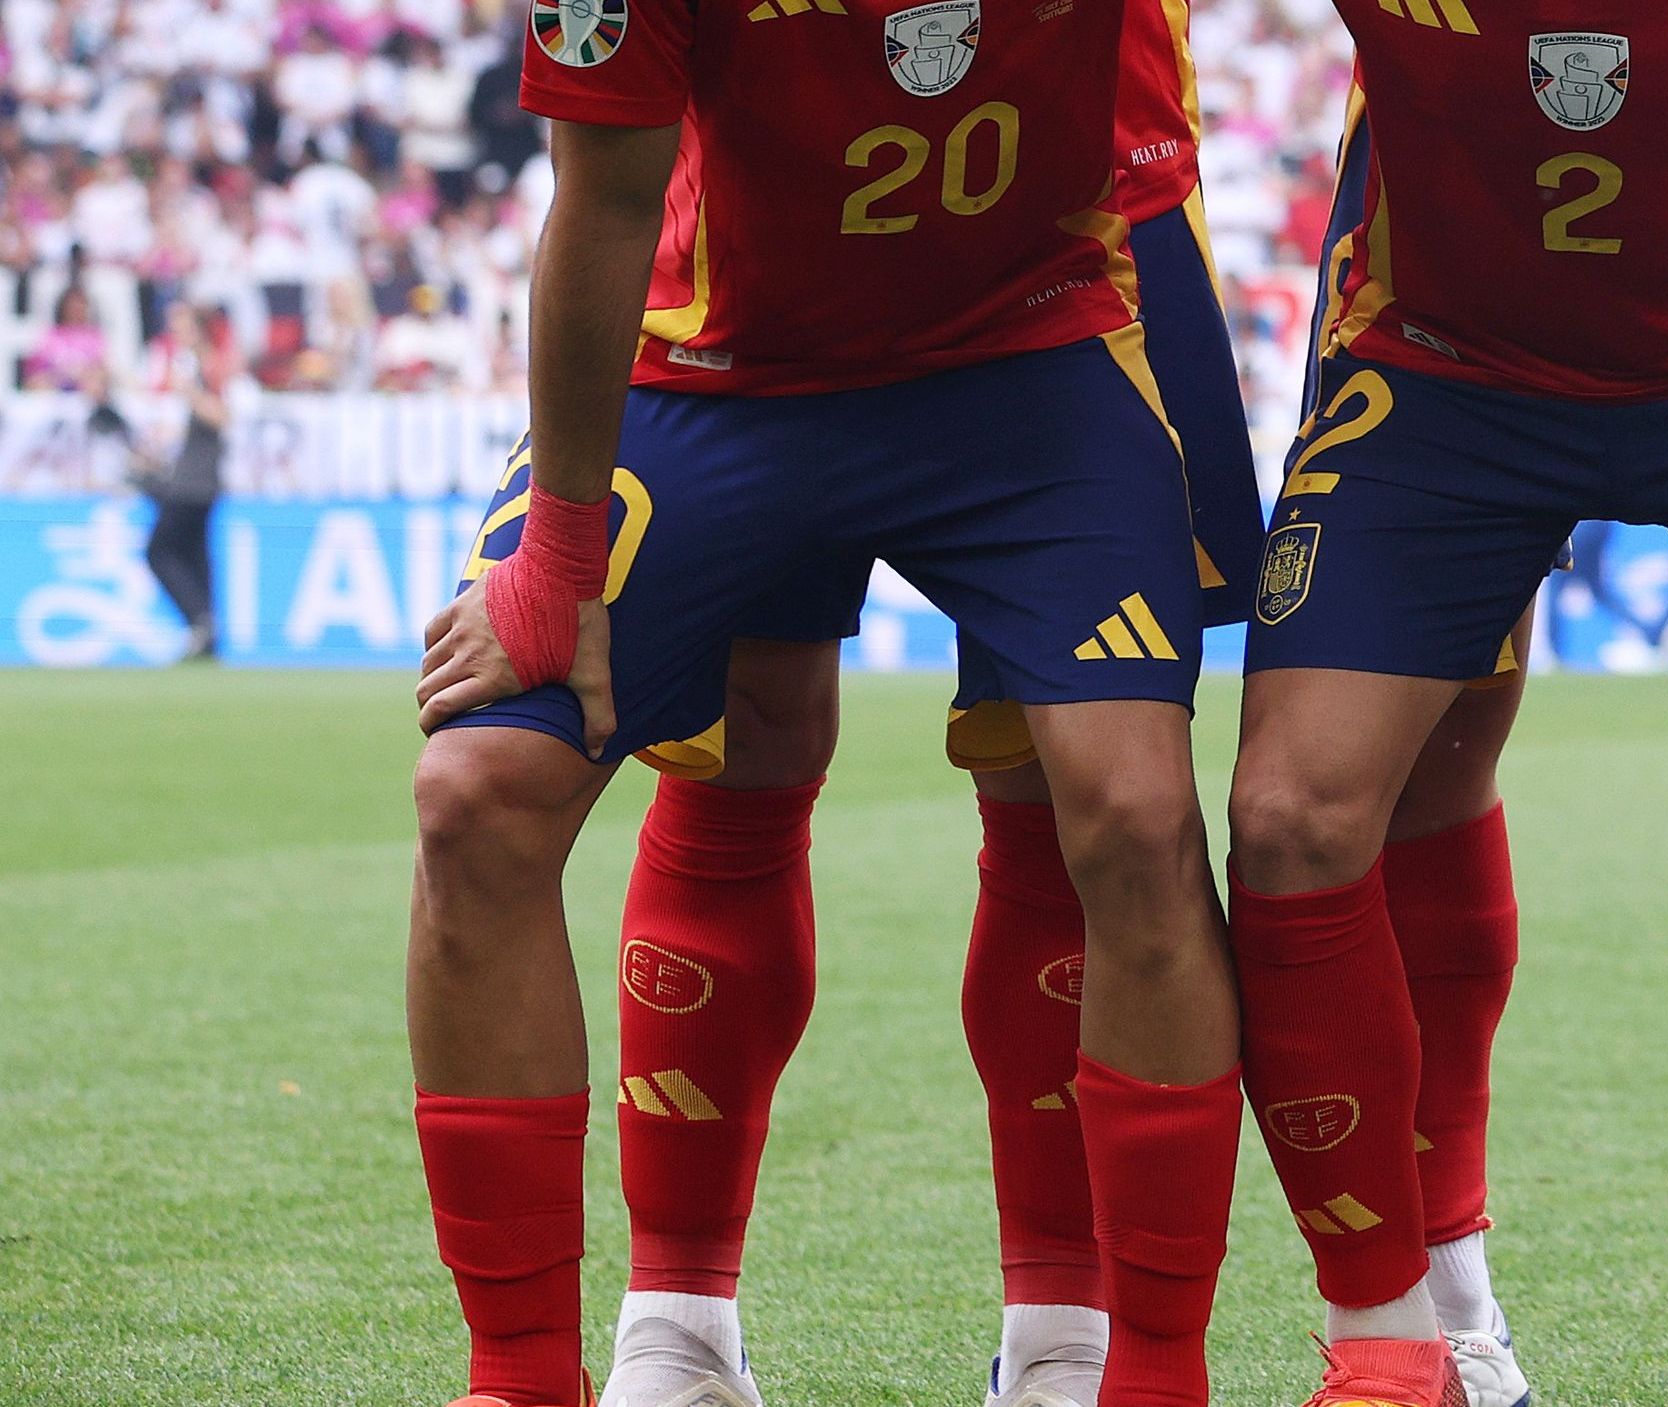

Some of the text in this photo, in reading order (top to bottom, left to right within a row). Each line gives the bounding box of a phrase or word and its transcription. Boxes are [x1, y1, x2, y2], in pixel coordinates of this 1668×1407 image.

[1534, 36, 1555, 45] UEFA
[1592, 36, 1624, 47] LEAGUE
[841, 101, 1020, 234] 20
[1130, 139, 1179, 166] HEAT.RDY
[1534, 152, 1624, 255] 2
[1281, 369, 1394, 499] 2
[1469, 1342, 1495, 1355] COPA
